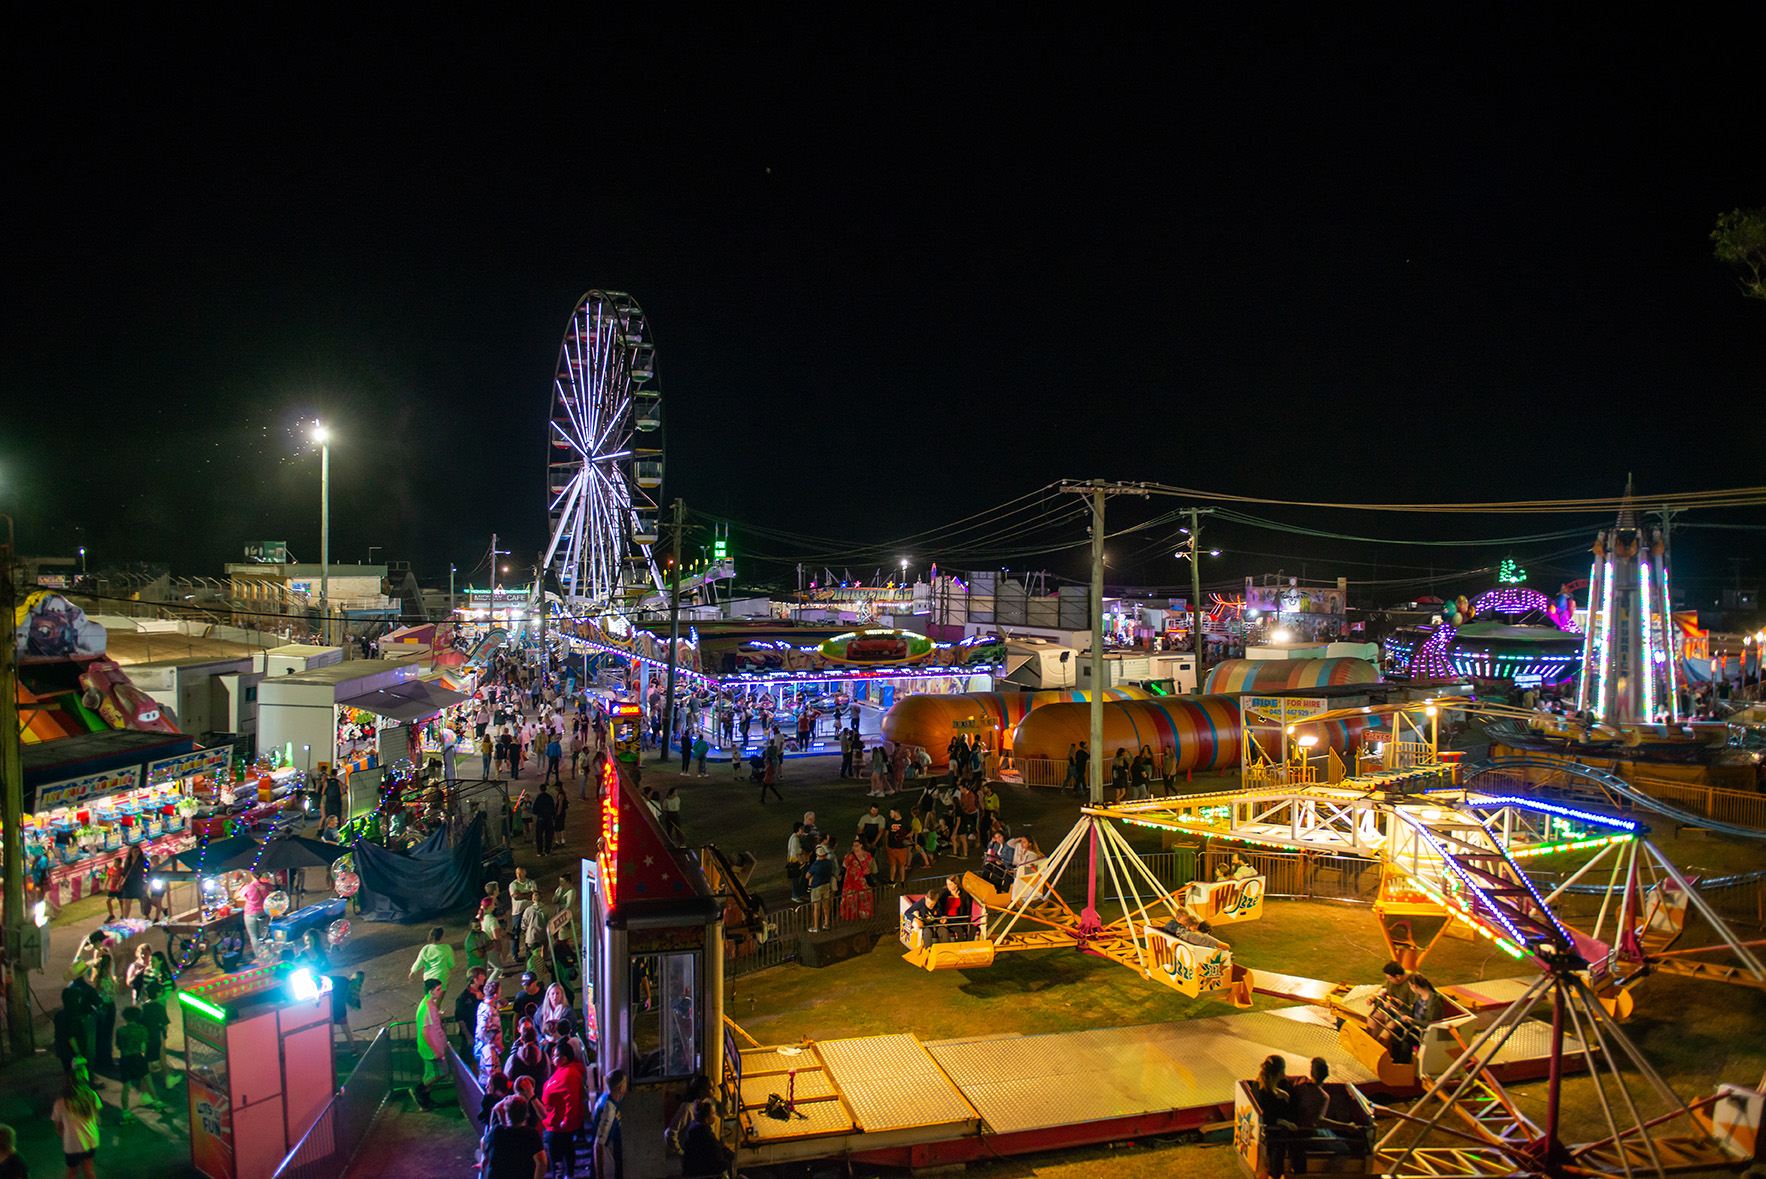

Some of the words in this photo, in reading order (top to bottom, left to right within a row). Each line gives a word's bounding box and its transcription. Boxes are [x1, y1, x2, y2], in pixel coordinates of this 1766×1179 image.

[507, 594, 526, 602] CAFE
[1252, 698, 1278, 707] RIDE
[1287, 699, 1302, 707] FOR
[1303, 700, 1321, 708] HIRE
[553, 911, 568, 930] EXIT
[23, 934, 39, 957] 4
[202, 1116, 221, 1139] FUN
